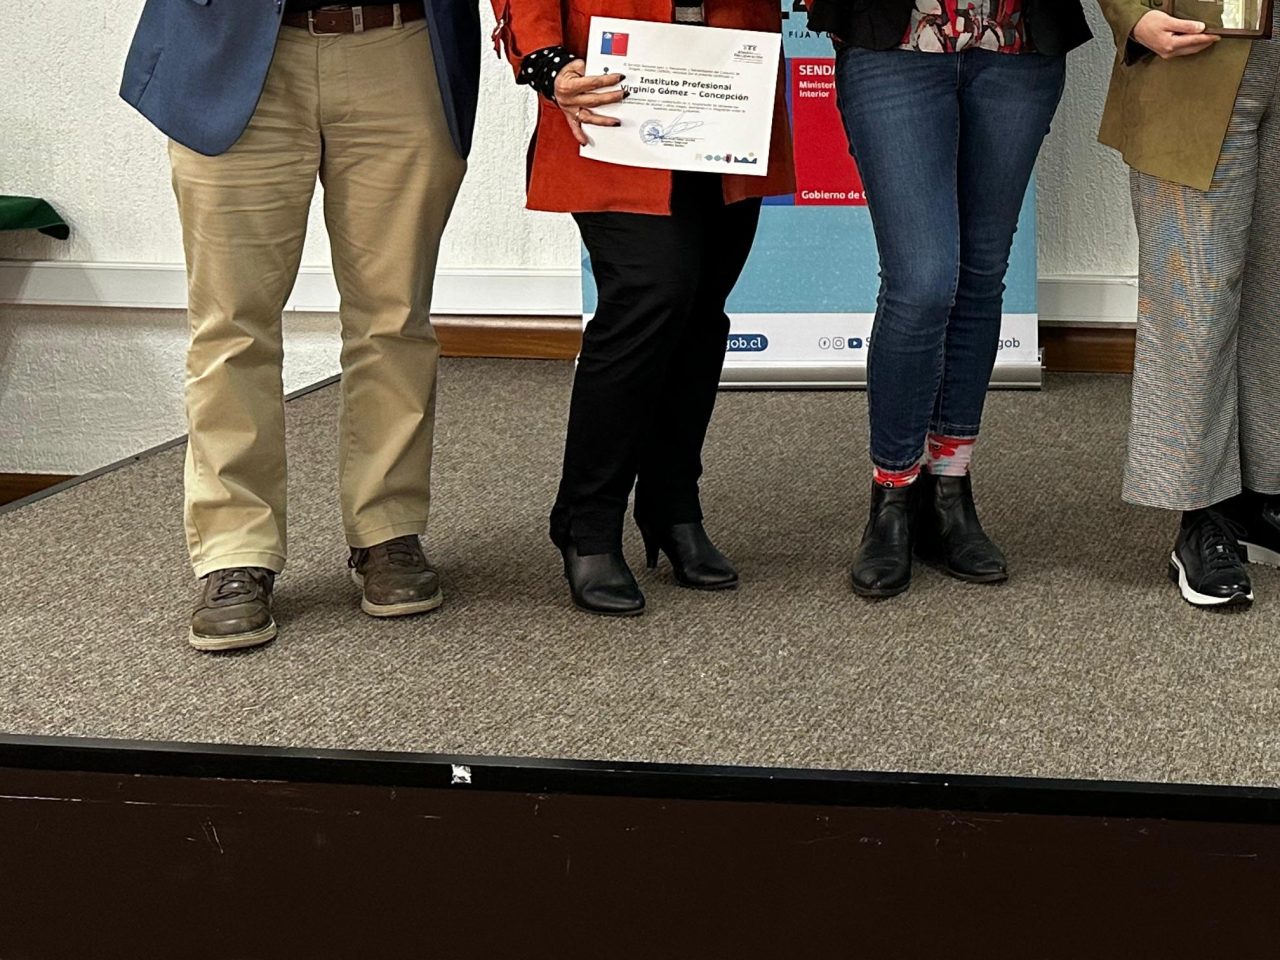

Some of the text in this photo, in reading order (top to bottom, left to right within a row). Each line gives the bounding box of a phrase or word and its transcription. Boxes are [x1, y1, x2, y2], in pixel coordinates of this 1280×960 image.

[788, 31, 811, 39] FIJA
[639, 76, 732, 91] Instituto Profesional
[658, 86, 689, 97] Gómez
[699, 90, 749, 102] Concepción
[799, 90, 830, 98] Interior
[801, 190, 846, 200] Gobierno
[847, 190, 860, 200] de
